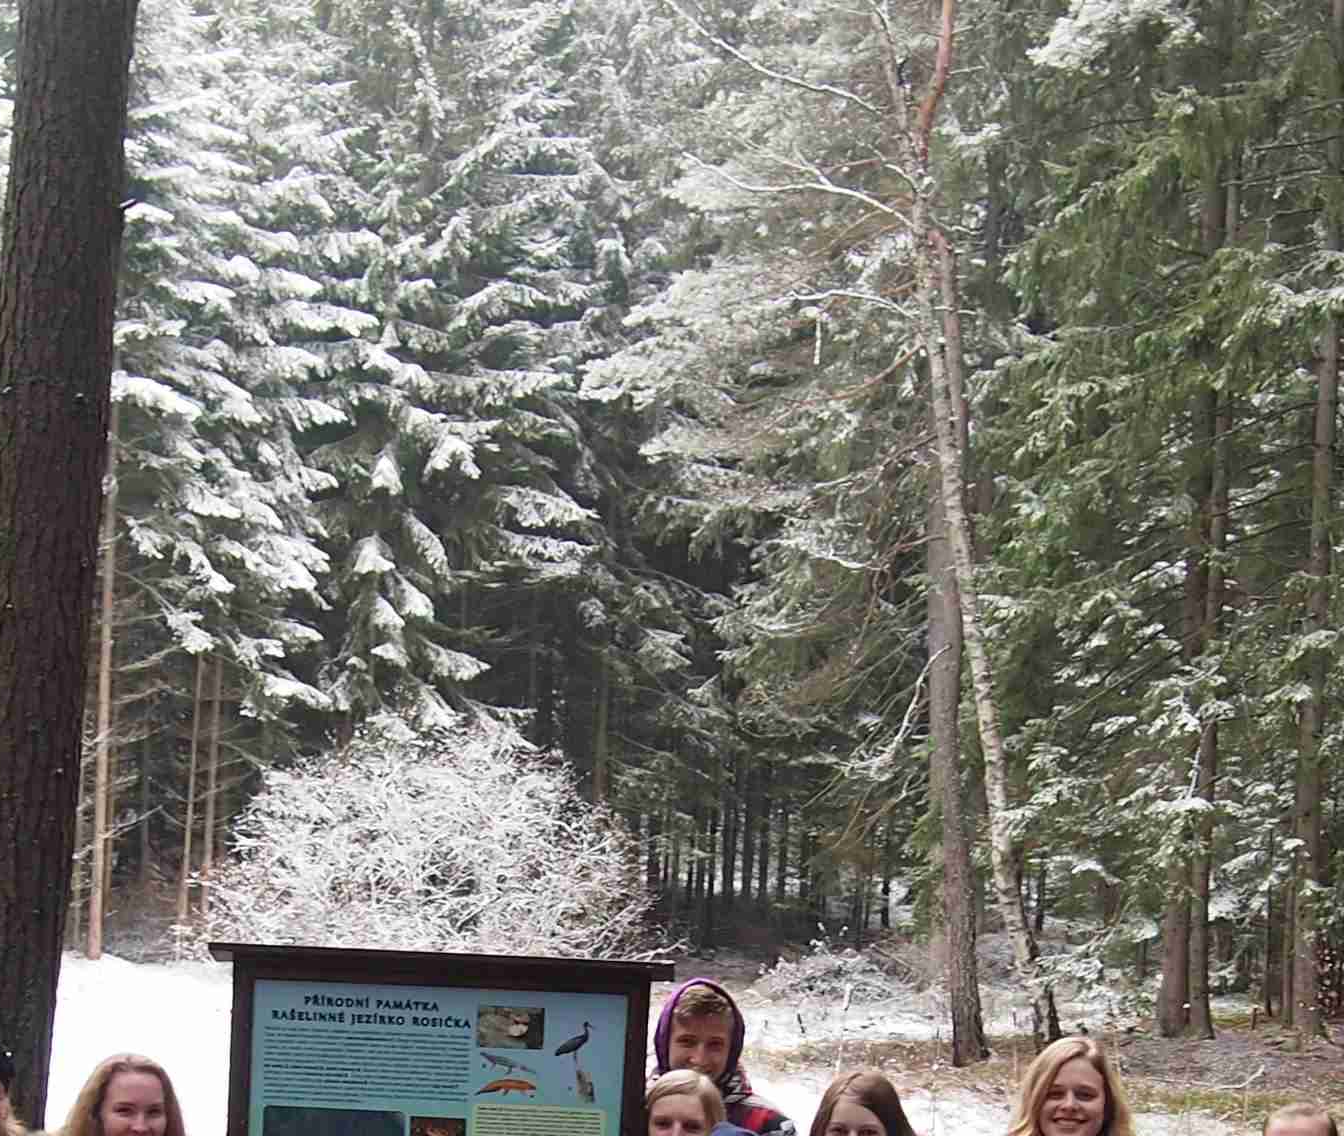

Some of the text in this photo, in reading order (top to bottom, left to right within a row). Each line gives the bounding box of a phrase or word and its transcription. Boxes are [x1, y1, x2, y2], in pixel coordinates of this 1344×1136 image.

[304, 994, 440, 1012] PŘÍRODNÍ PAMÁTKA
[351, 1013, 406, 1026] JEZÍRKO
[412, 1015, 472, 1030] ROSIČKA
